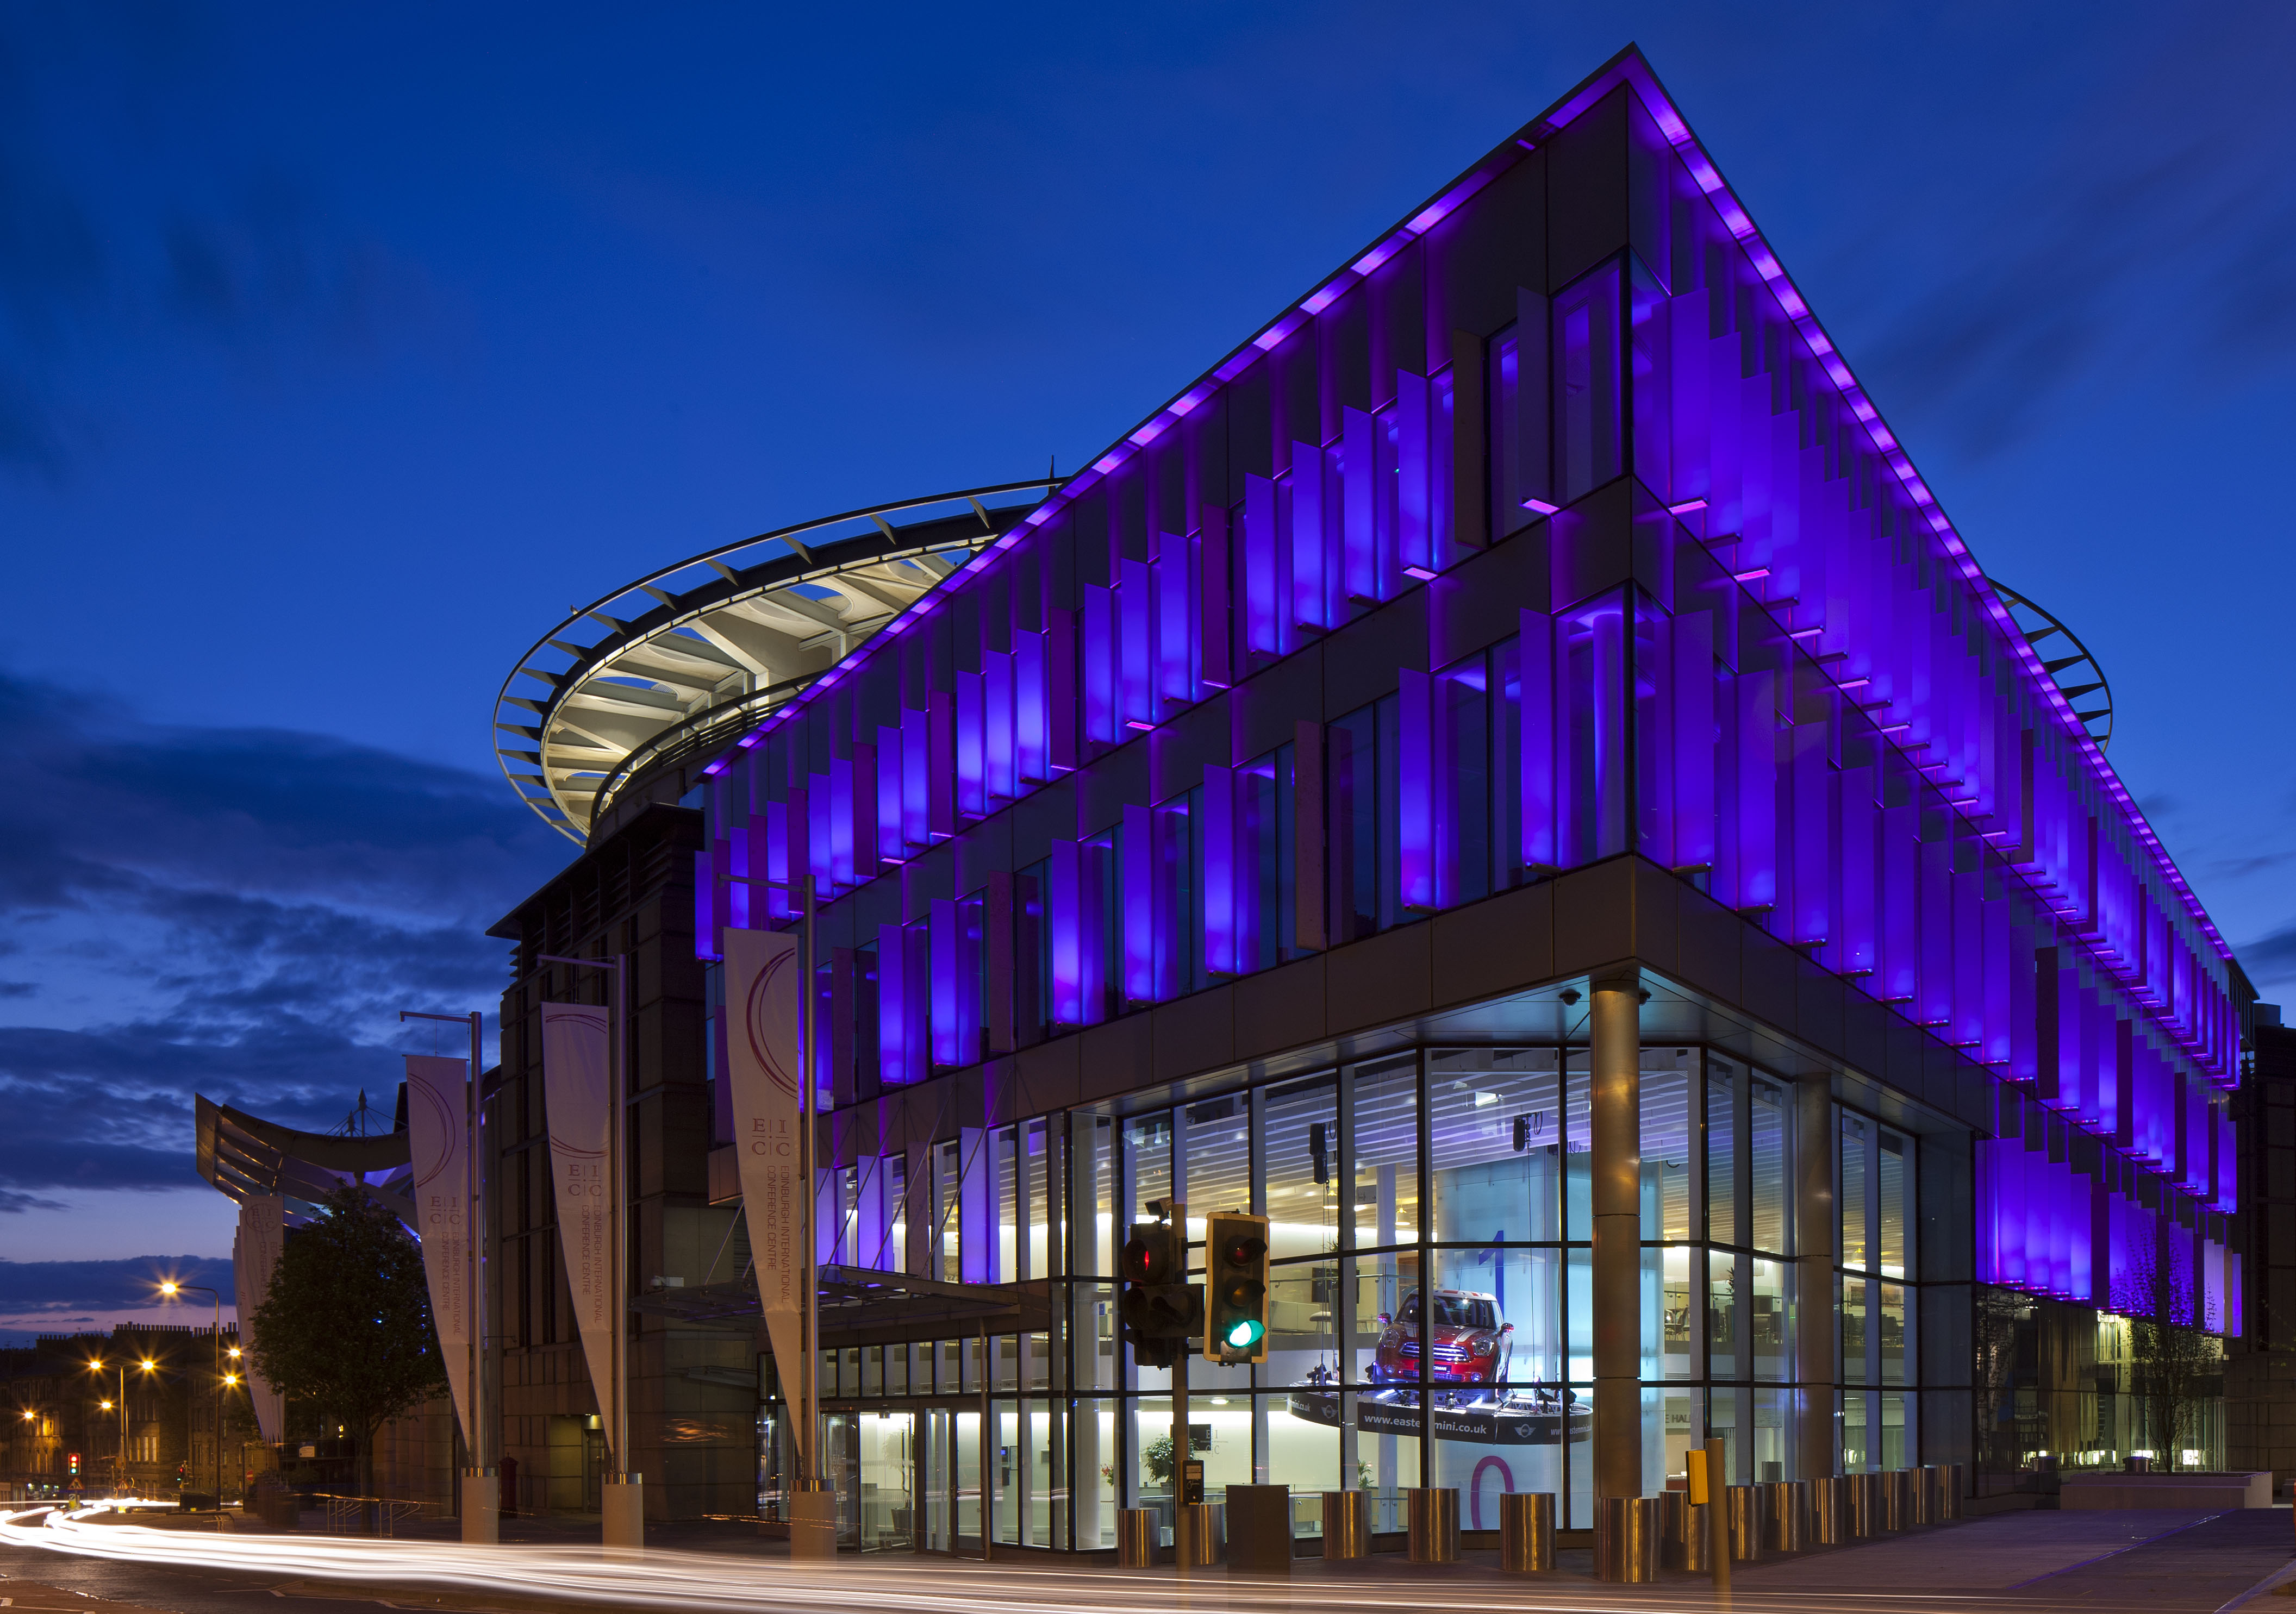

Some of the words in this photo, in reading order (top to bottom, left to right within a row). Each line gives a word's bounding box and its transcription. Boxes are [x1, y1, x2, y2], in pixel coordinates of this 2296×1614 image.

[767, 1166, 776, 1230] CONFERENCE
[781, 1166, 790, 1223] EDINBURGH
[452, 1231, 460, 1275] EDINBURGH
[582, 1205, 590, 1261] CONFERENCE
[594, 1205, 602, 1255] EDINBURGH
[768, 1232, 777, 1270] CENTRE
[441, 1231, 450, 1280] CONFERENCE
[582, 1262, 590, 1296] CENTRE
[781, 1227, 791, 1304] INTERNATIONAL
[442, 1282, 450, 1311] CENTRE
[452, 1277, 461, 1335] INTERNATIONAL
[594, 1257, 603, 1323] INTERNATIONAL
[1364, 1415, 1487, 1434] www.eastemini.co.uk
